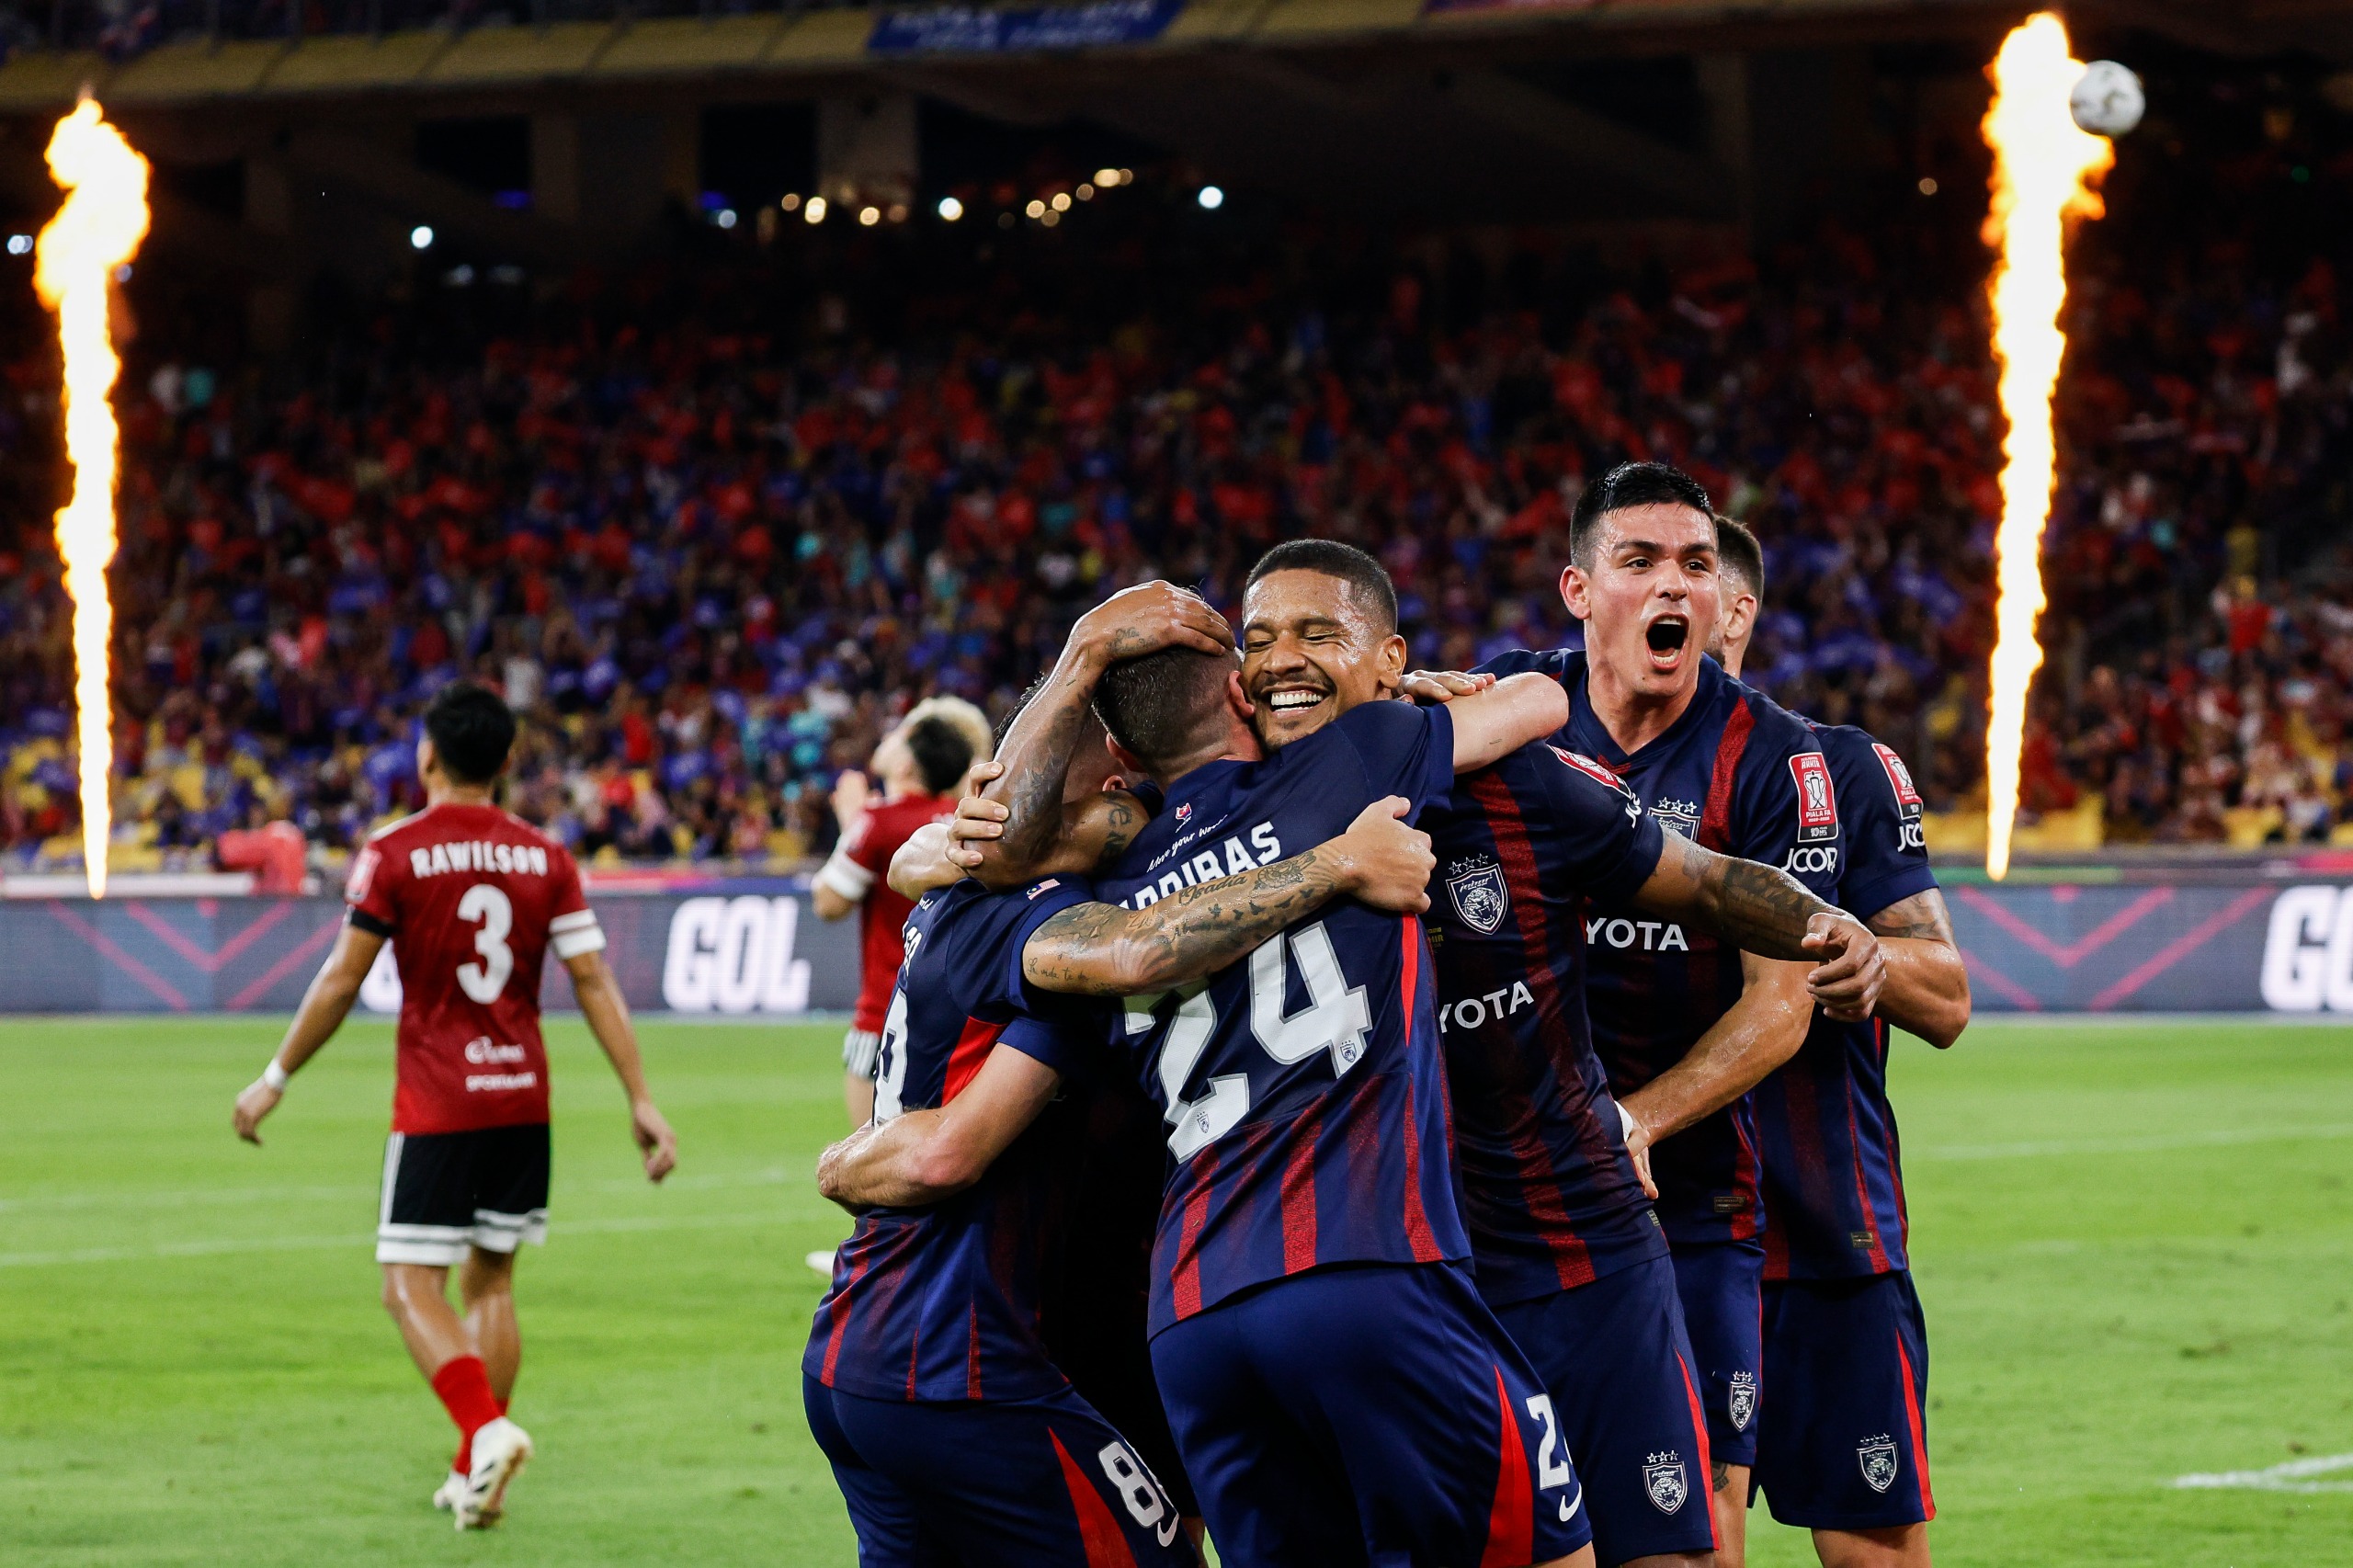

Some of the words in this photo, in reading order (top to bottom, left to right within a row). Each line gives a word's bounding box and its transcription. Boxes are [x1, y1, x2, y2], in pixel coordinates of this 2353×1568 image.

[410, 840, 549, 879] RAWILSON
[1171, 832, 1196, 858] your
[456, 882, 515, 1005] 3
[662, 896, 812, 1012] GOL
[1586, 917, 1689, 951] YOTA
[1122, 919, 1373, 1165] 24
[1526, 1392, 1574, 1491] 2
